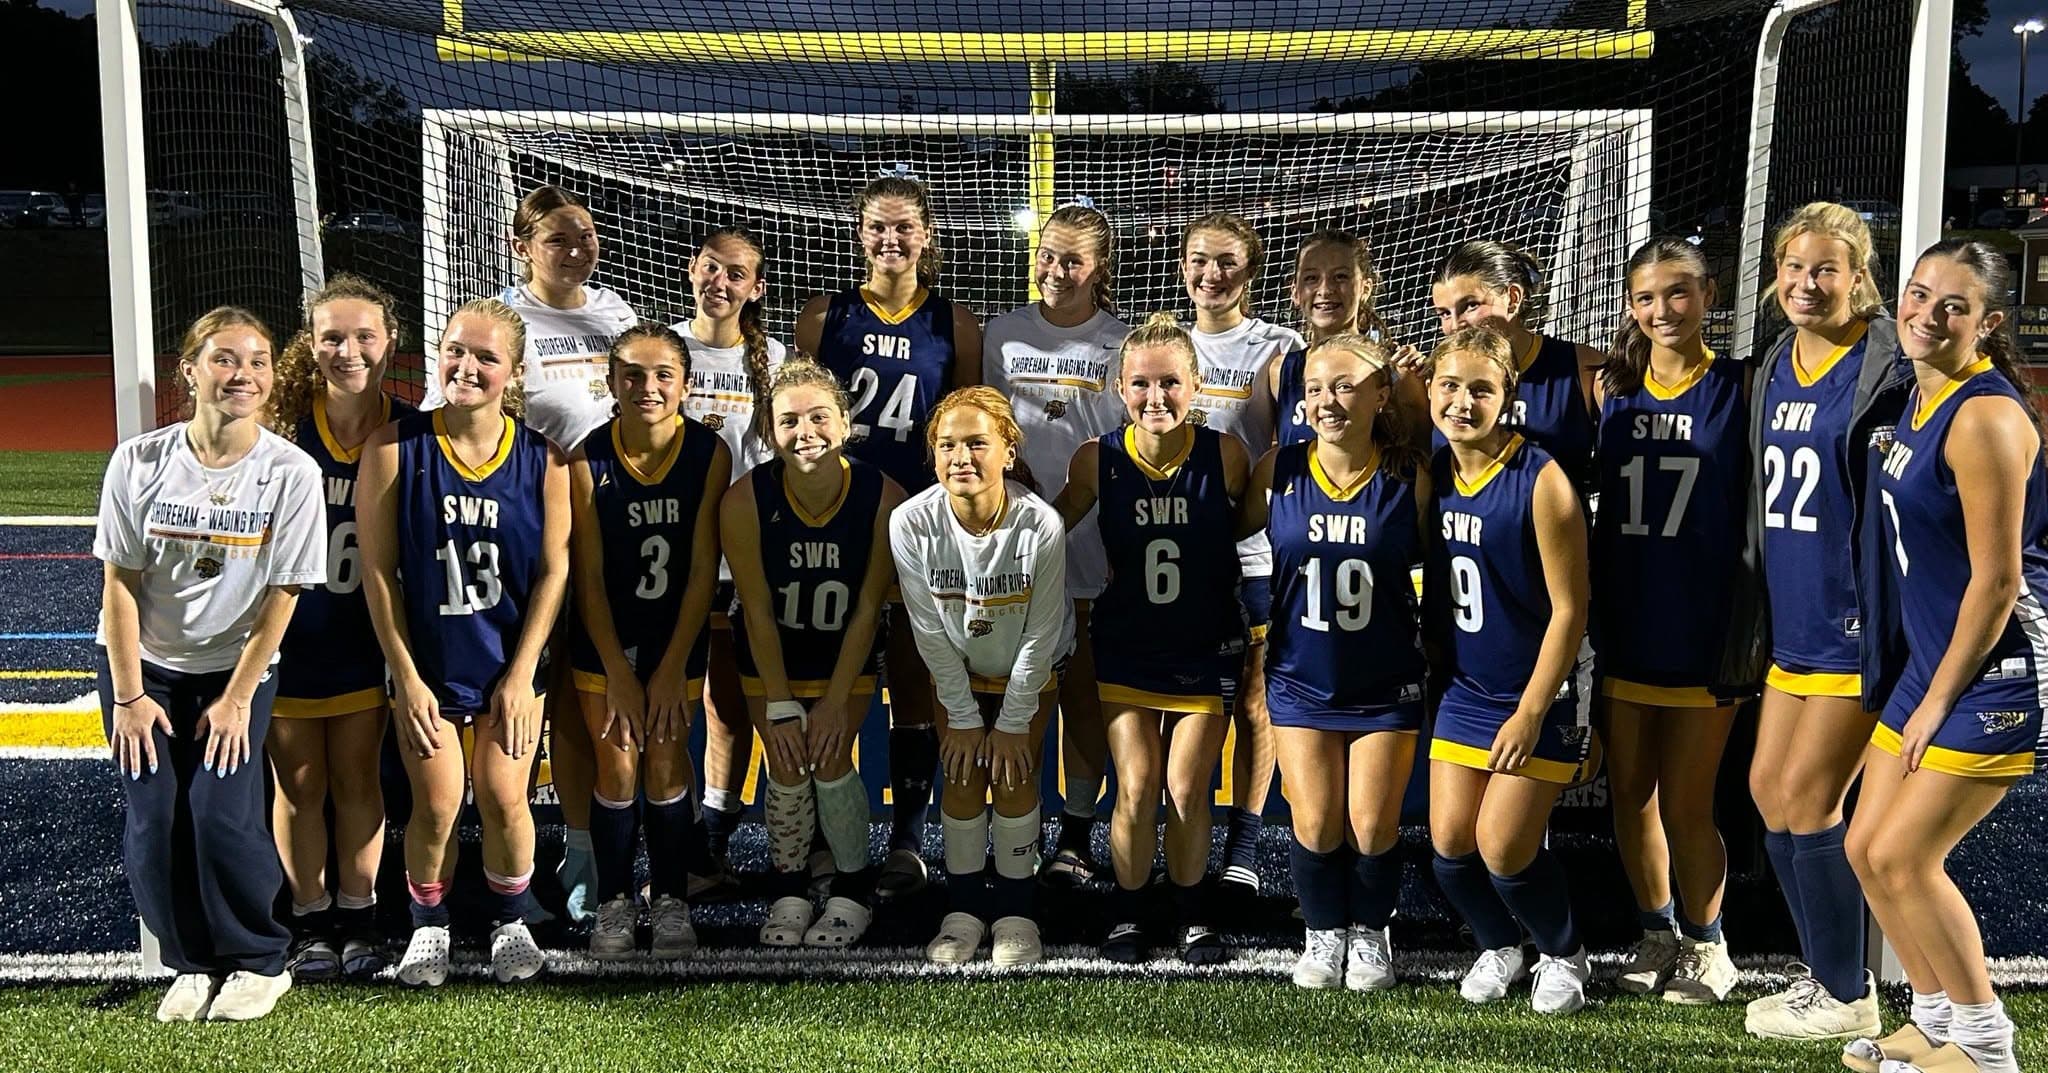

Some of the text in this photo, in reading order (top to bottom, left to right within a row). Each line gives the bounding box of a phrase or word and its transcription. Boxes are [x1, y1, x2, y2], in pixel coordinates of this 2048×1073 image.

[2039, 307, 2048, 320] G
[534, 335, 579, 357] SHOREHAM
[862, 333, 911, 360] SWR
[714, 372, 743, 393] WADING
[1010, 357, 1050, 374] SHOREHAM
[1056, 358, 1086, 377] WADING
[1086, 361, 1109, 380] RIVER
[1203, 367, 1255, 388] WADING RIVER
[711, 402, 748, 414] HOCK
[849, 366, 918, 442] 24
[1771, 401, 1817, 432] SWR
[1632, 413, 1693, 441] SWR
[1882, 440, 1913, 481] SWR
[1620, 455, 1700, 537] 17
[1763, 444, 1821, 532] 22
[151, 502, 200, 528] SHOREHAM
[208, 508, 247, 533] WADING
[247, 511, 275, 534] RIVER
[444, 494, 499, 529] SWR
[628, 498, 680, 527] SWR
[1135, 497, 1189, 526] SWR
[1308, 513, 1367, 545] SWR
[1442, 511, 1482, 547] SWR
[635, 534, 670, 600] 3
[790, 542, 840, 569] SWR
[1144, 538, 1180, 604] 6
[436, 539, 502, 616] 13
[976, 576, 1008, 597] WADING
[1008, 573, 1031, 593] RIVER
[777, 580, 849, 631] 10
[1298, 557, 1374, 632] 19
[1450, 555, 1484, 633] 9
[977, 605, 1025, 618] HOCKE
